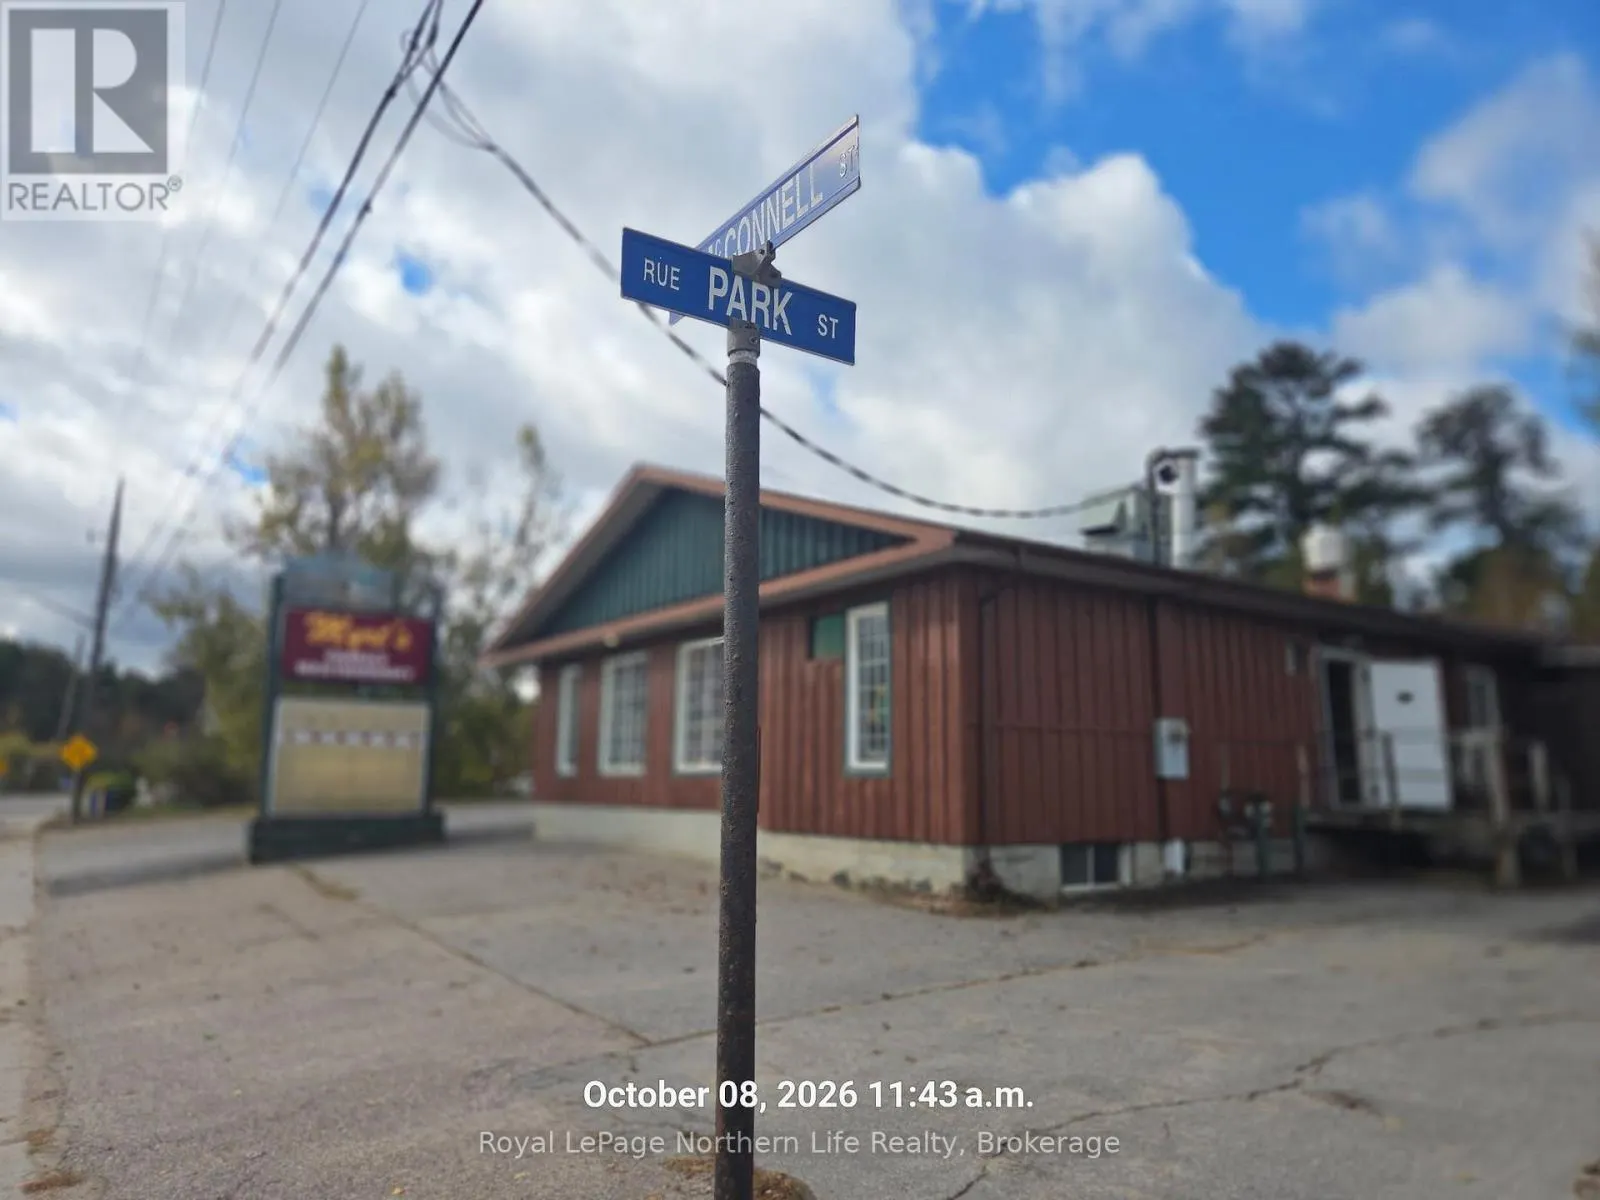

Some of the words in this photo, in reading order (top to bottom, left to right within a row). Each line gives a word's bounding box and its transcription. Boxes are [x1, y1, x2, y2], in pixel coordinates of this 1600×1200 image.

[643, 257, 681, 291] RUE
[708, 265, 793, 336] PARK
[817, 313, 839, 339] ST
